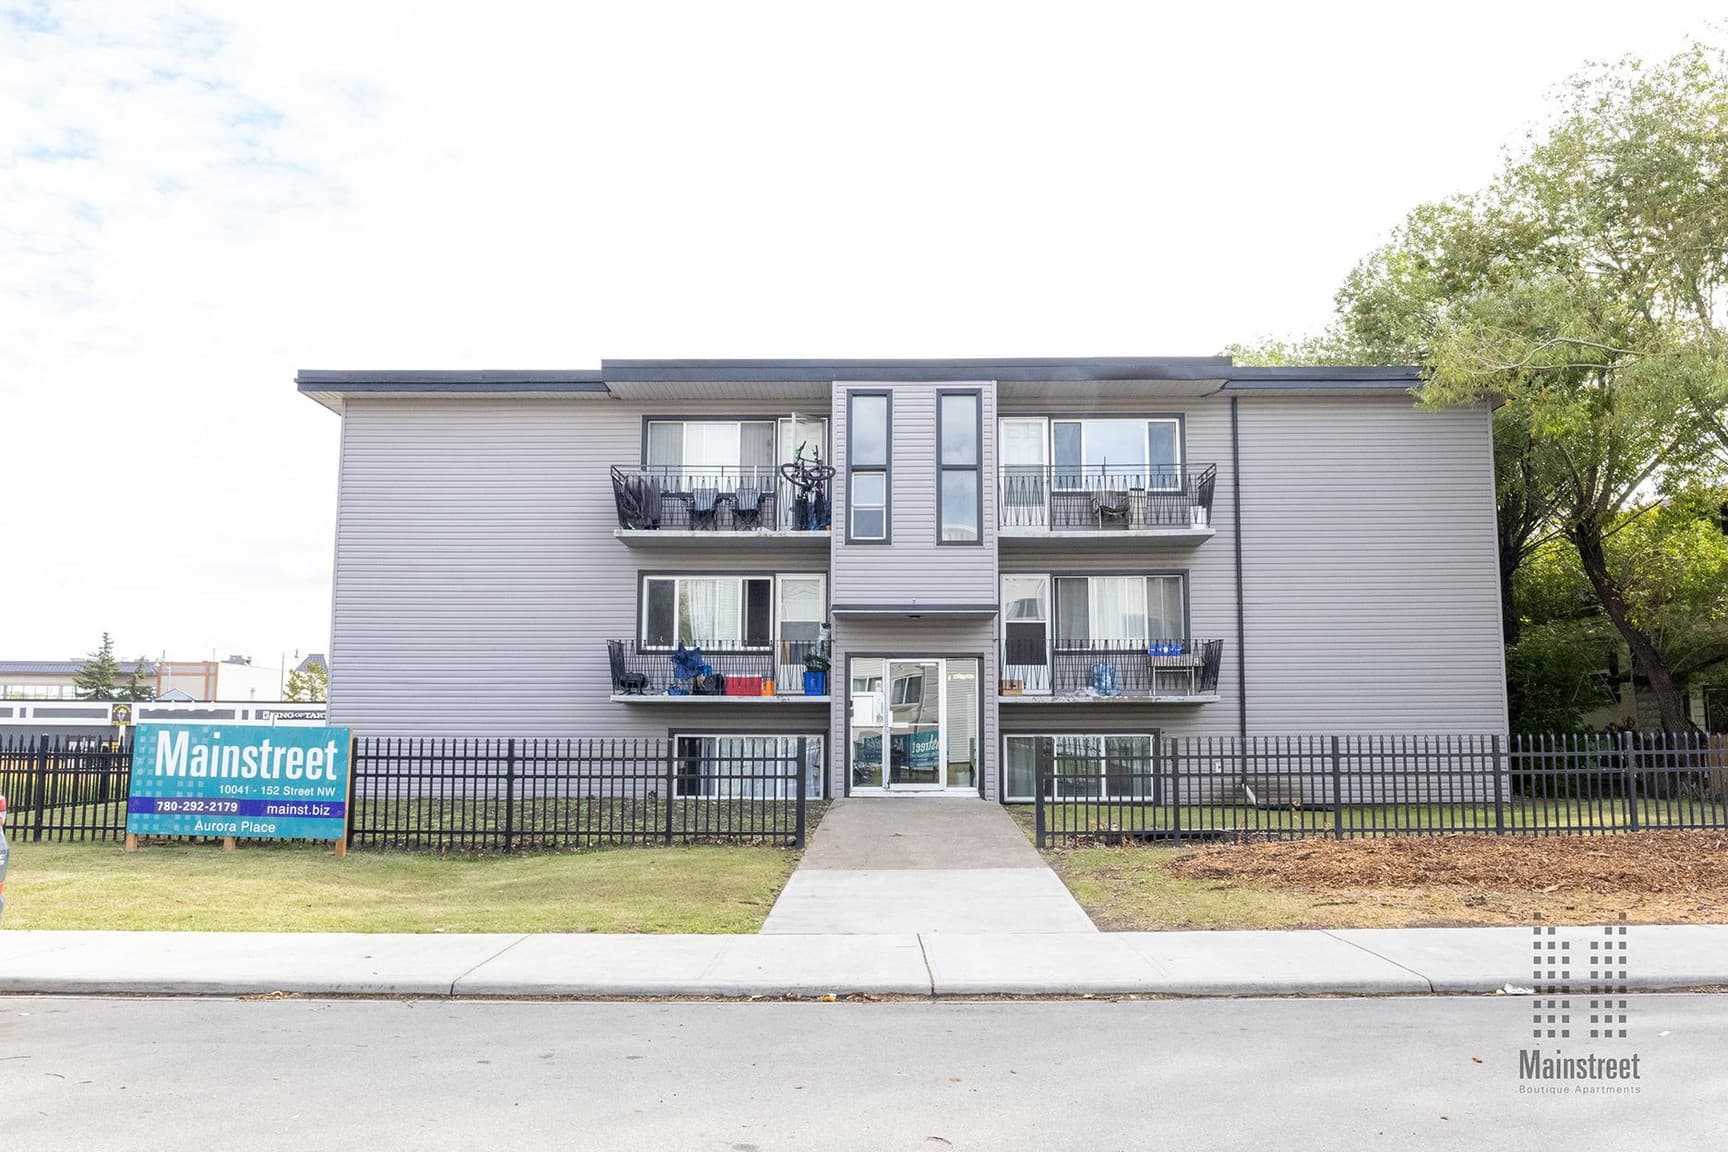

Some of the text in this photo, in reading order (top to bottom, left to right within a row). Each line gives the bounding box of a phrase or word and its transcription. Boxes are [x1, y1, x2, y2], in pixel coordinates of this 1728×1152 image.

[155, 730, 338, 780] Mainstreet
[219, 784, 249, 795] 10041
[261, 786, 280, 796] 152
[283, 786, 314, 797] Street
[317, 787, 336, 797] NW
[157, 801, 330, 816] 780-292-2179 mainst.biz
[194, 820, 276, 833] Aurora Place
